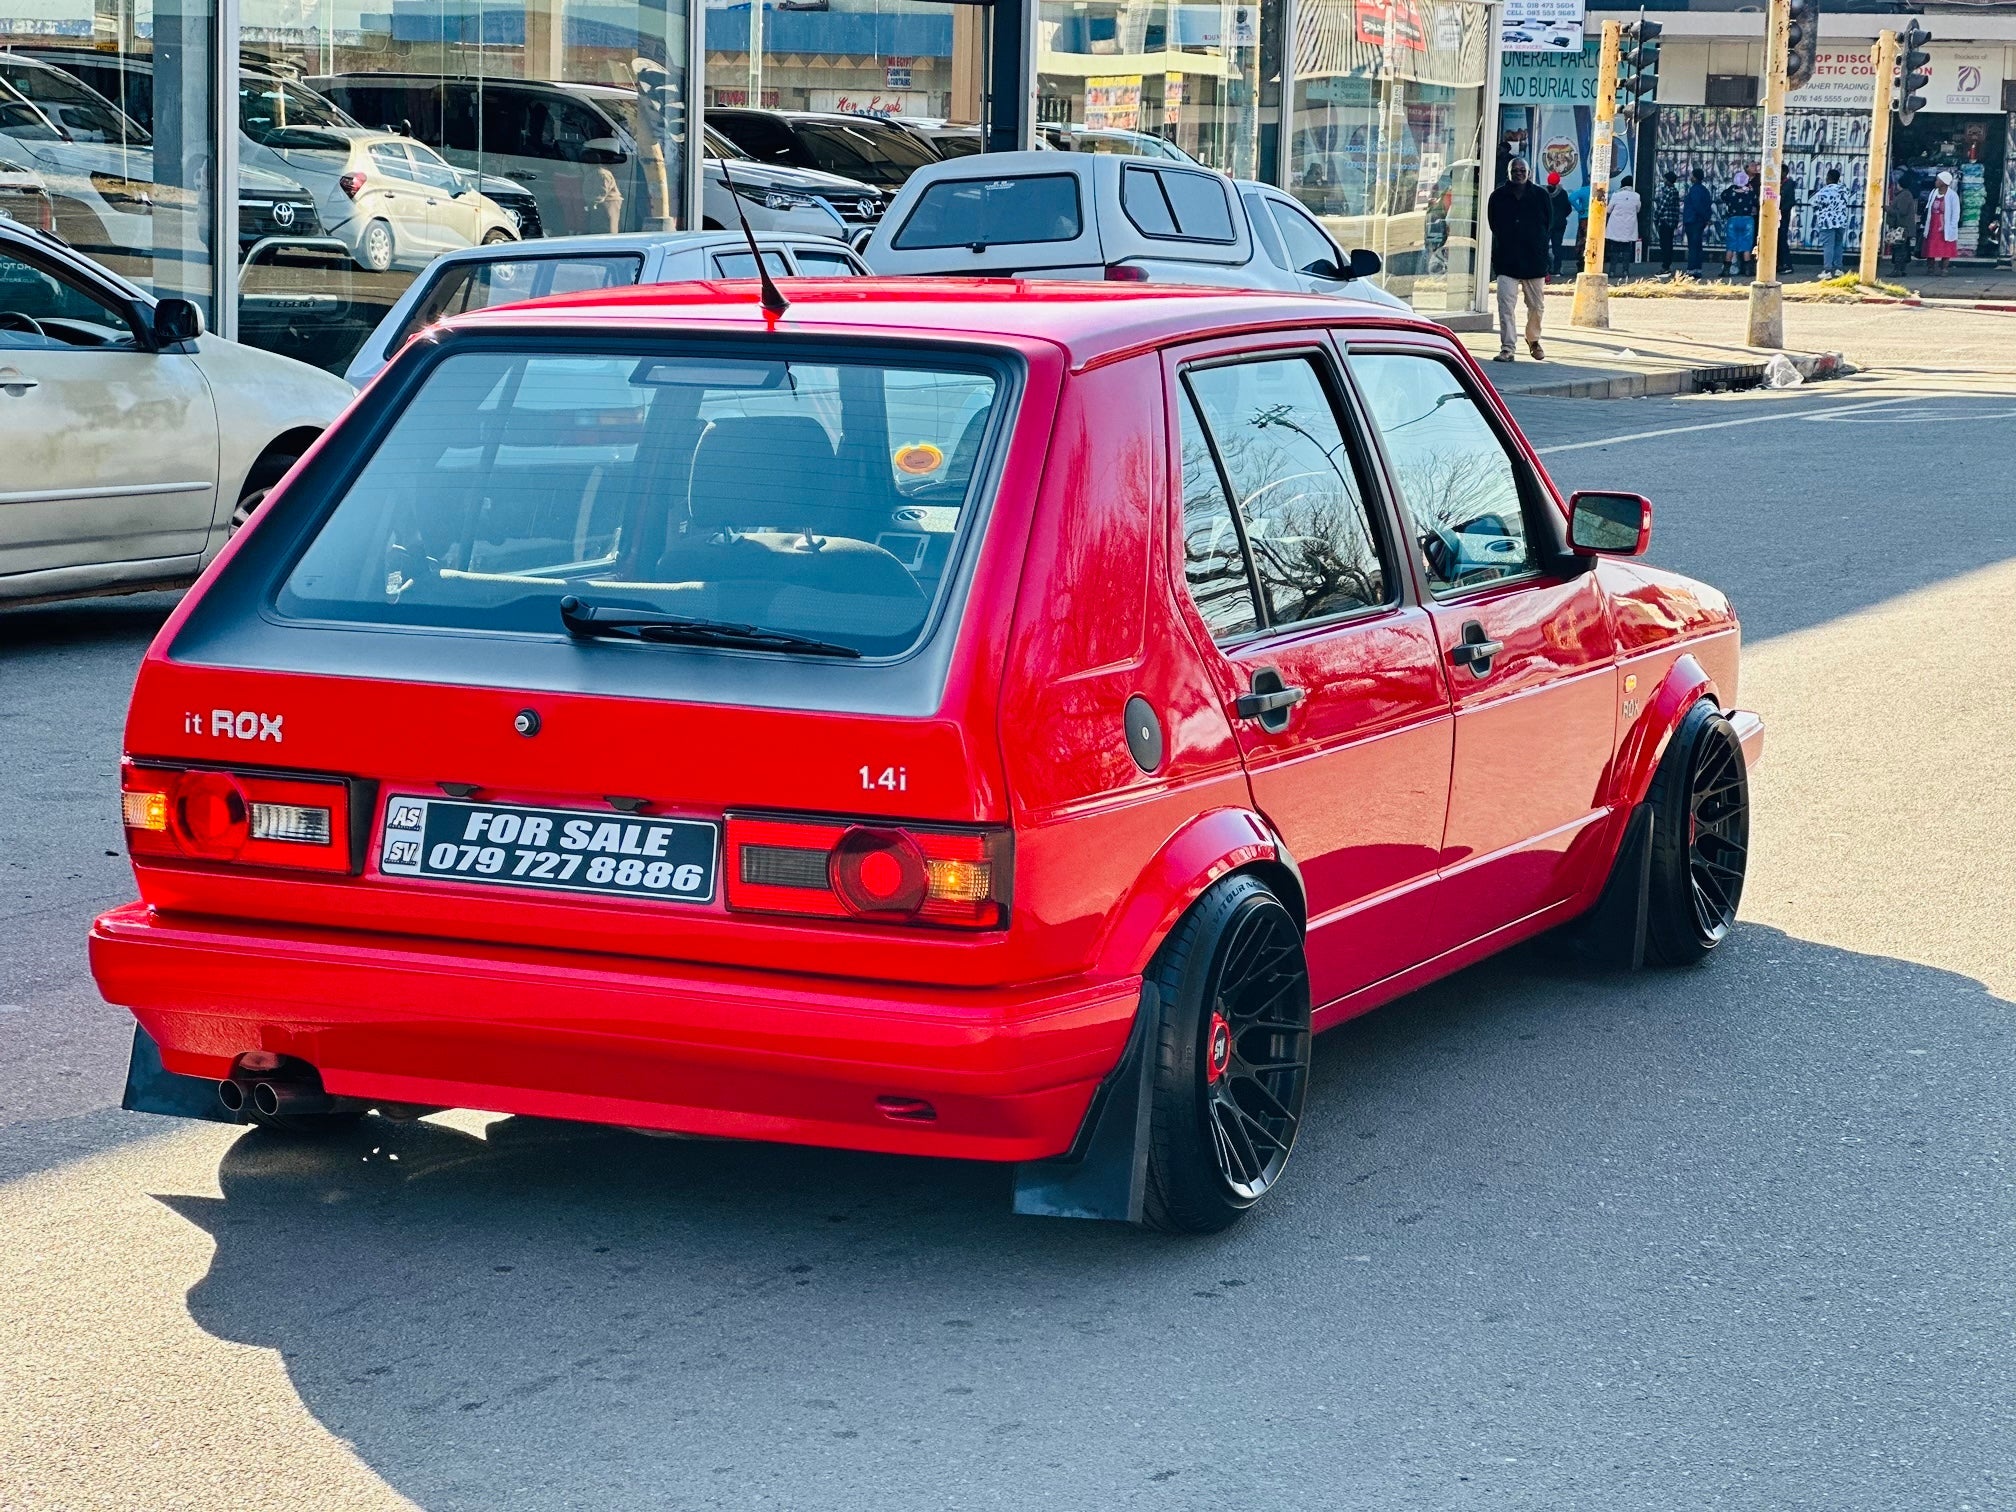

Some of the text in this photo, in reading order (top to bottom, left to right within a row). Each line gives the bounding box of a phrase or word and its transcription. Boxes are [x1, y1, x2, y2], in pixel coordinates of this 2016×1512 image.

[1502, 50, 1557, 67] UNERAL
[1530, 77, 1577, 98] BURIAL
[1833, 82, 1869, 91] TRADING
[184, 709, 283, 743] it ROX
[858, 765, 907, 791] 1.4i
[392, 806, 422, 827] AS
[462, 811, 673, 857] FOR SALE
[389, 841, 418, 861] SV
[428, 842, 704, 892] 079 727 8886
